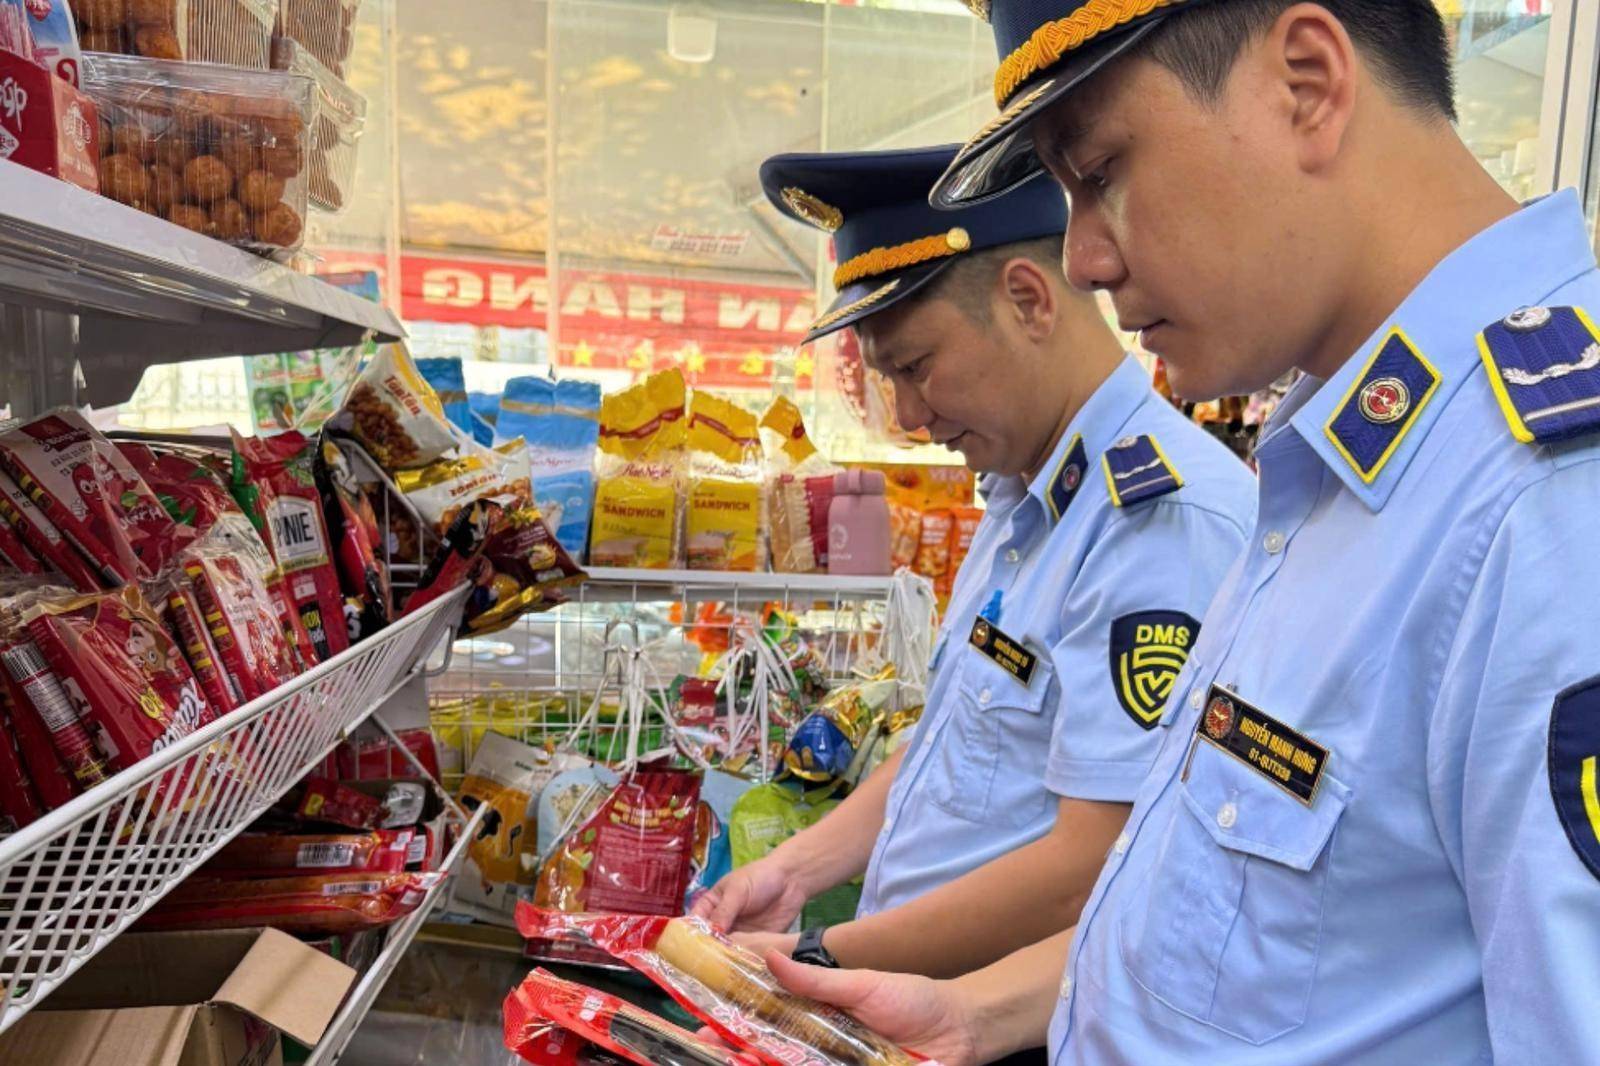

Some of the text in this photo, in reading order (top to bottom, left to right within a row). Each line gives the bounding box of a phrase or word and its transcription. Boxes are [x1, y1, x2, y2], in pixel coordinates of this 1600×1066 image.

[603, 502, 665, 519] SANDWICH
[694, 499, 750, 511] SANDWICH
[1136, 624, 1190, 647] DMS
